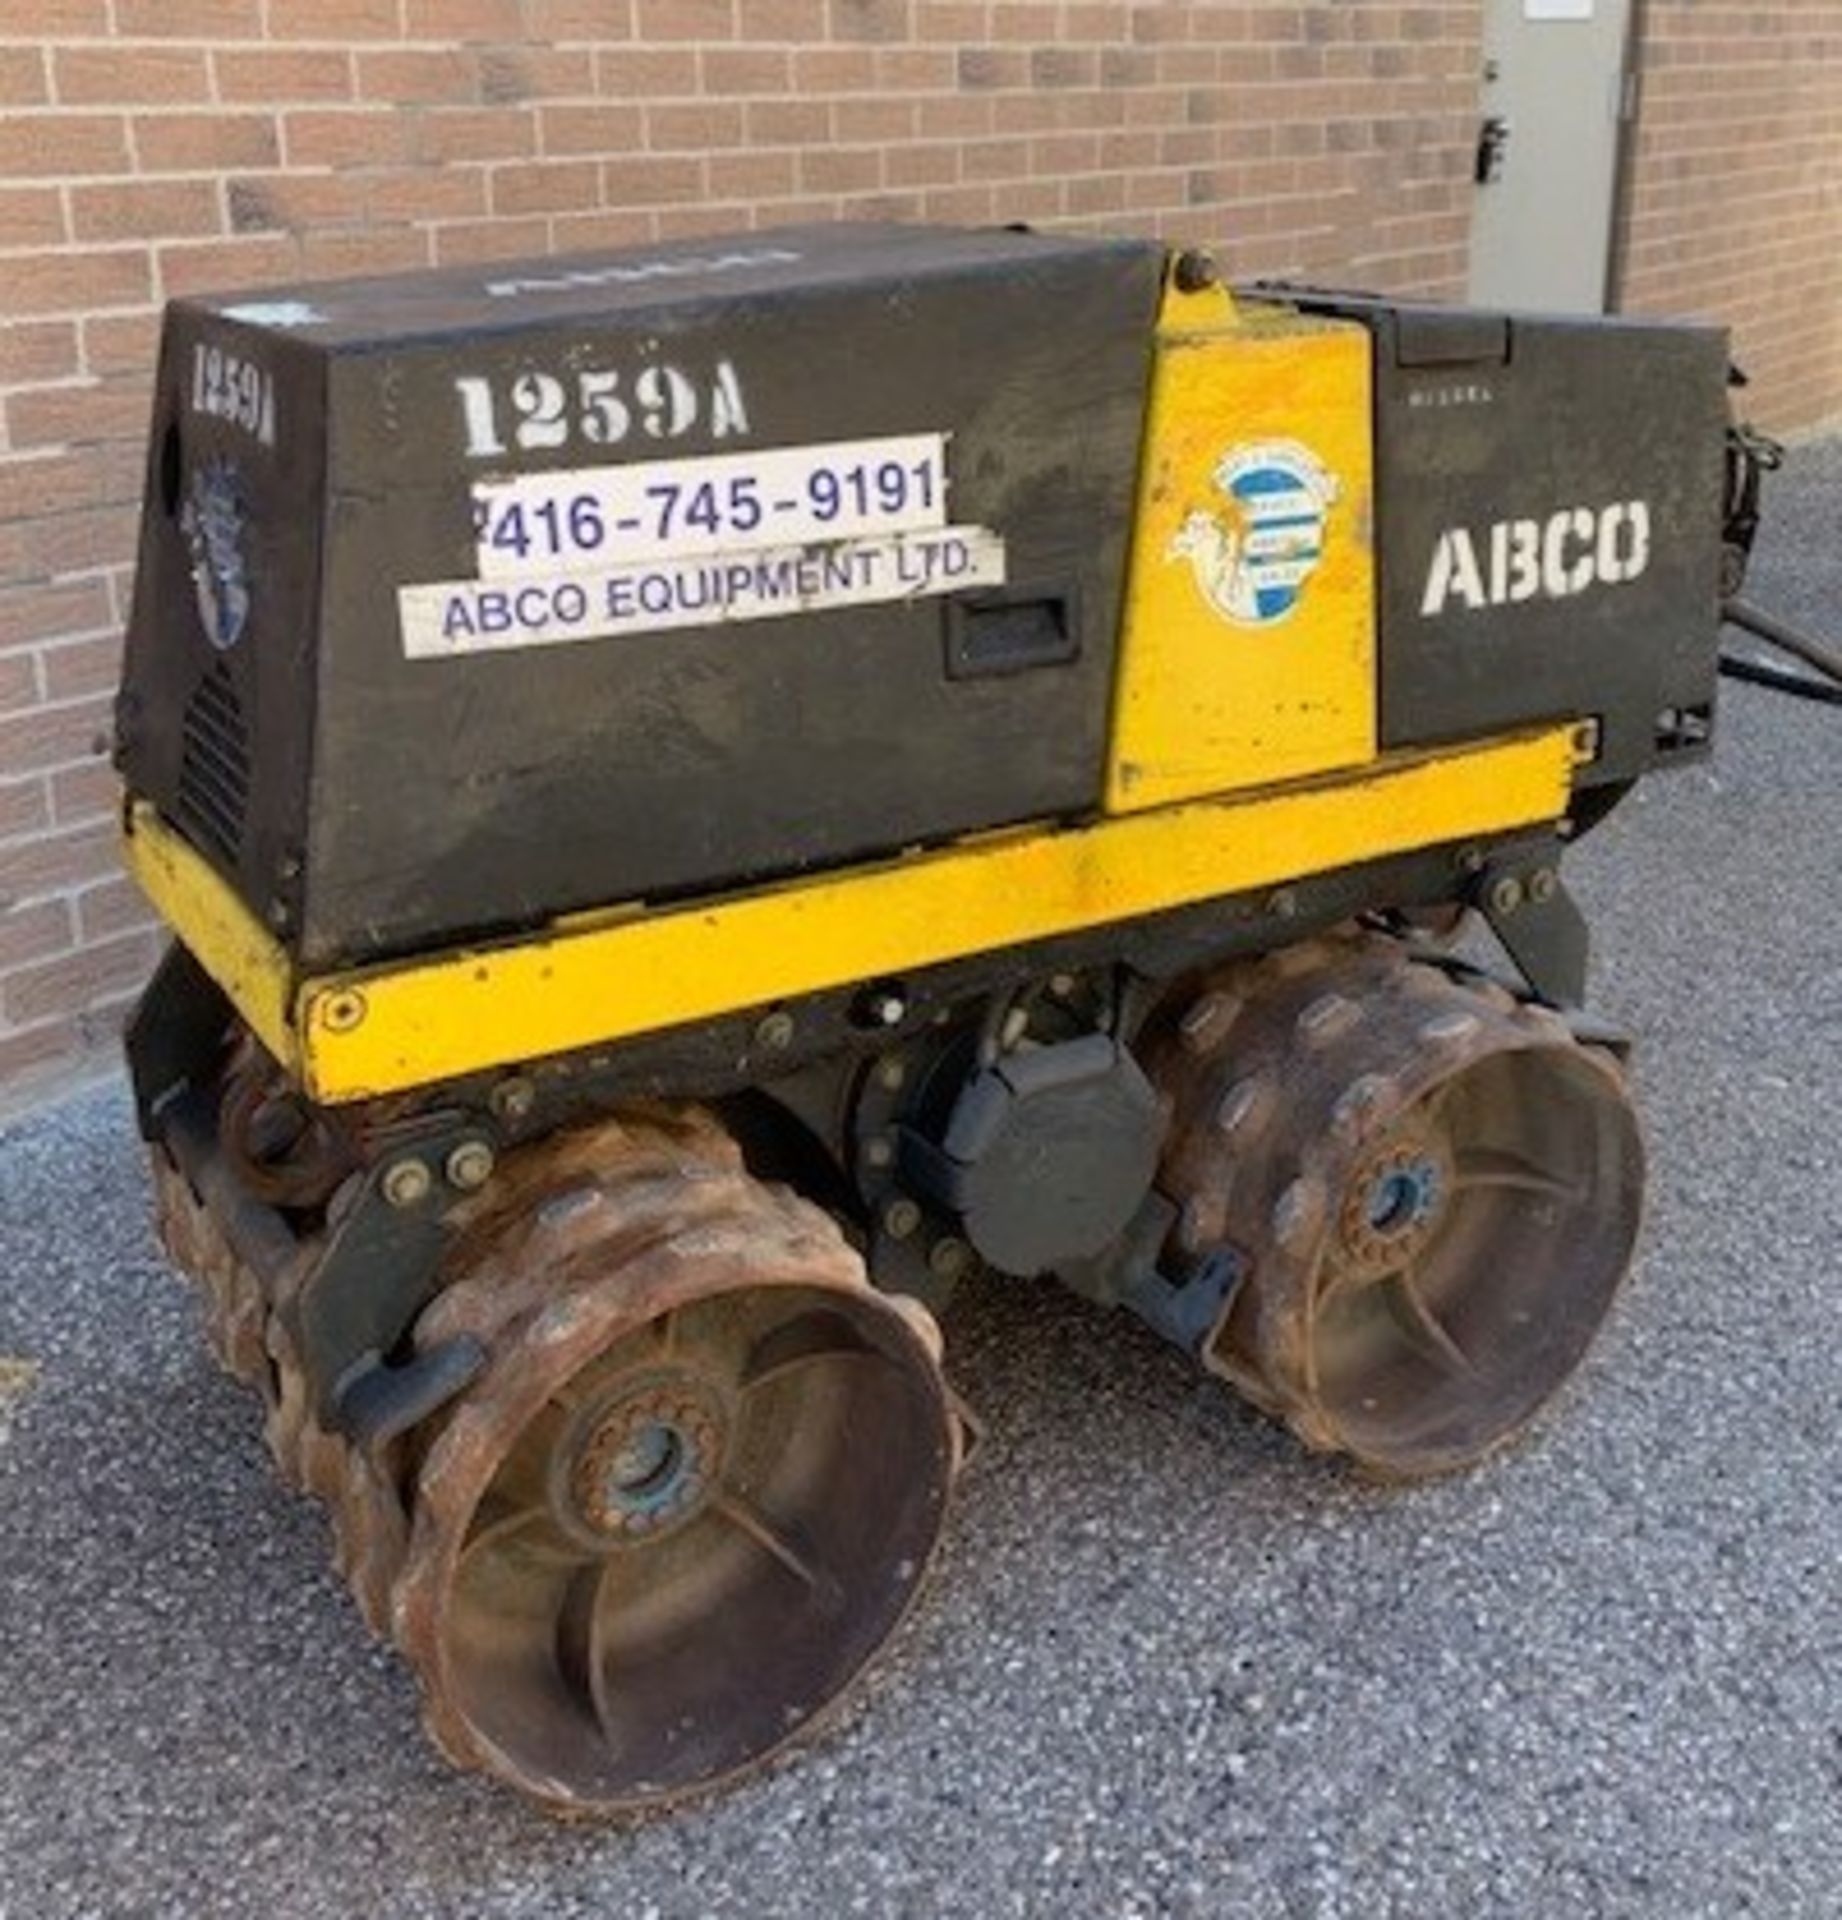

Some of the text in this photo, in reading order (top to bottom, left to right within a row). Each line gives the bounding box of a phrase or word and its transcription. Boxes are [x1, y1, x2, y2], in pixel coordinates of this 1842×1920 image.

[455, 359, 750, 457] 1259A
[492, 459, 932, 558] 416-745-9191
[442, 538, 978, 637] ABCO EQUIPMENT LTD.
[1419, 500, 1650, 617] ABCO
